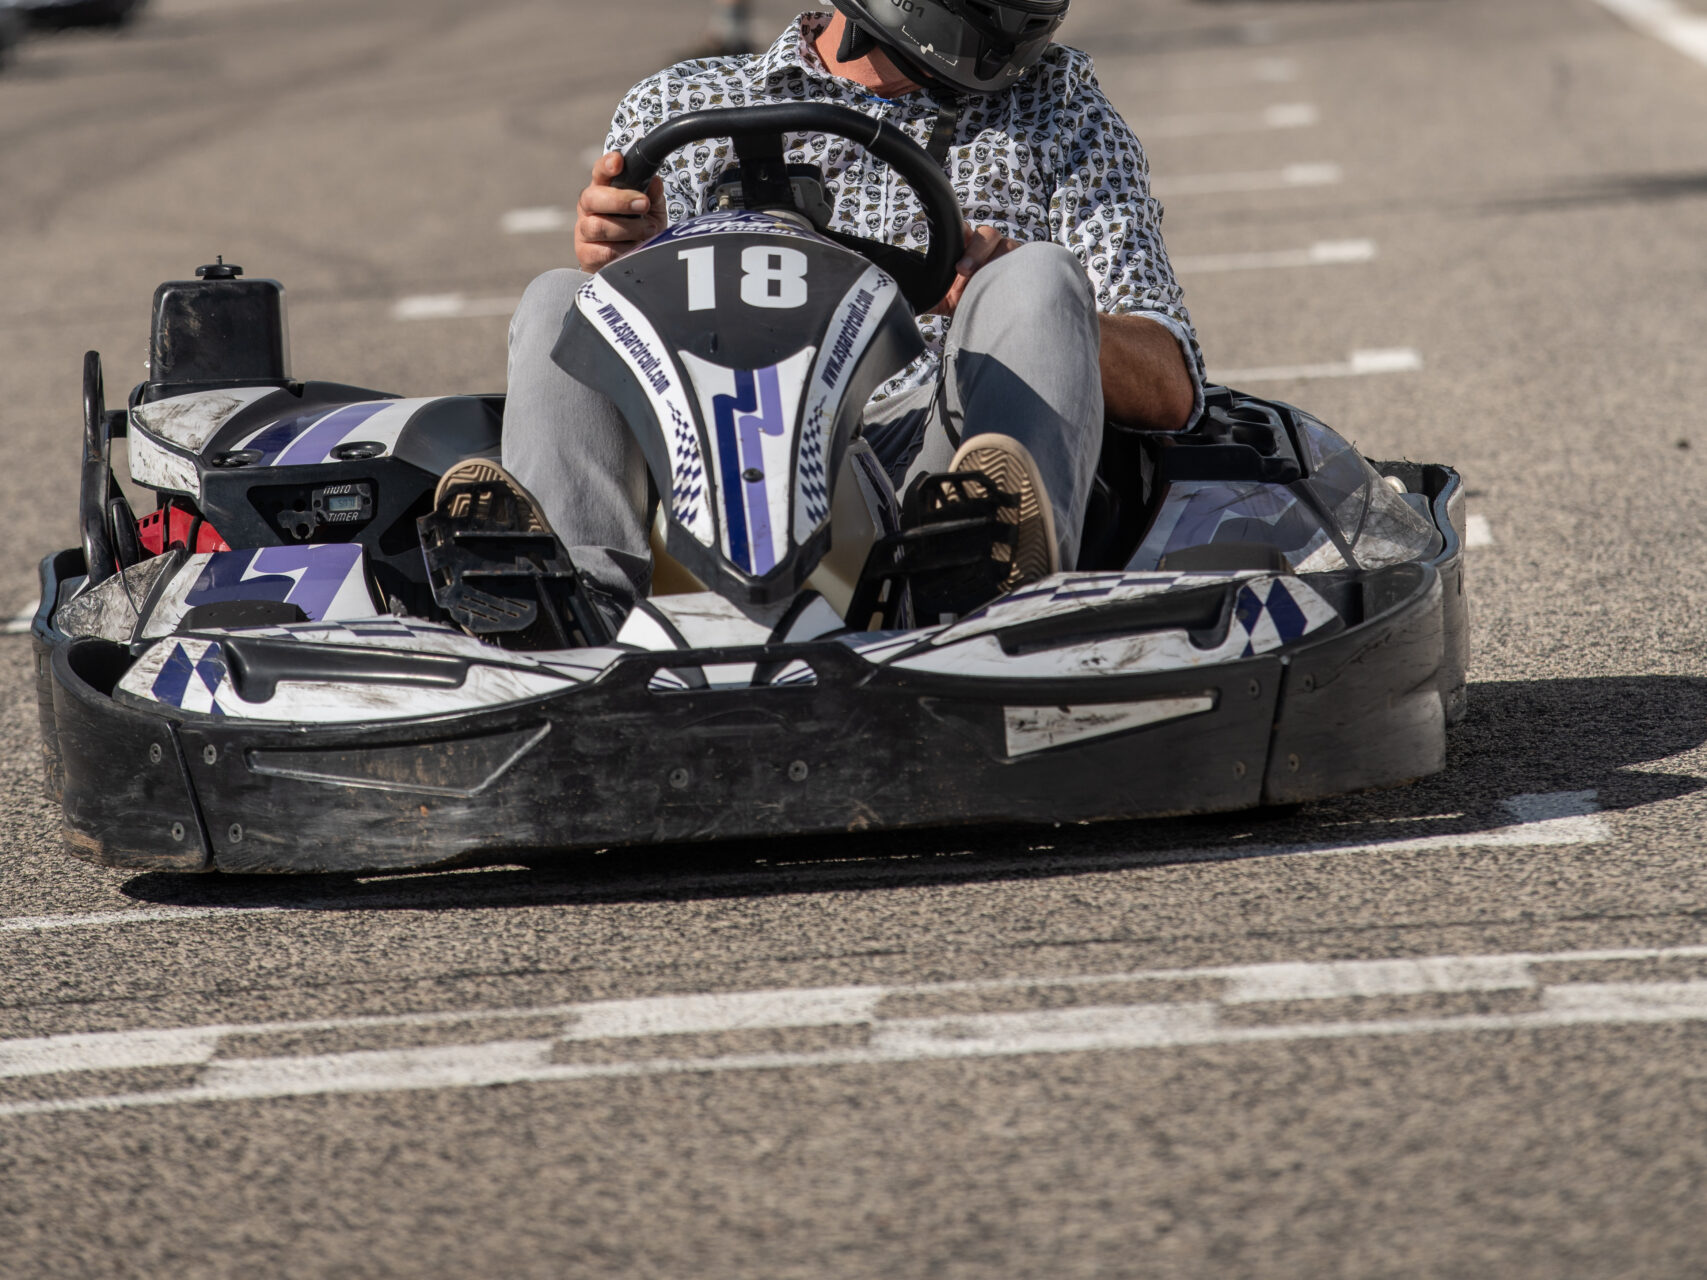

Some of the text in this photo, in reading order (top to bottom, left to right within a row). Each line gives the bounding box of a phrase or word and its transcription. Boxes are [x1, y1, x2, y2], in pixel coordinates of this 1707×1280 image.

[677, 245, 808, 312] 18
[597, 303, 671, 396] www.asparcircuit.com
[821, 288, 875, 390] www.asparcircuit.com
[328, 511, 359, 523] TIMER
